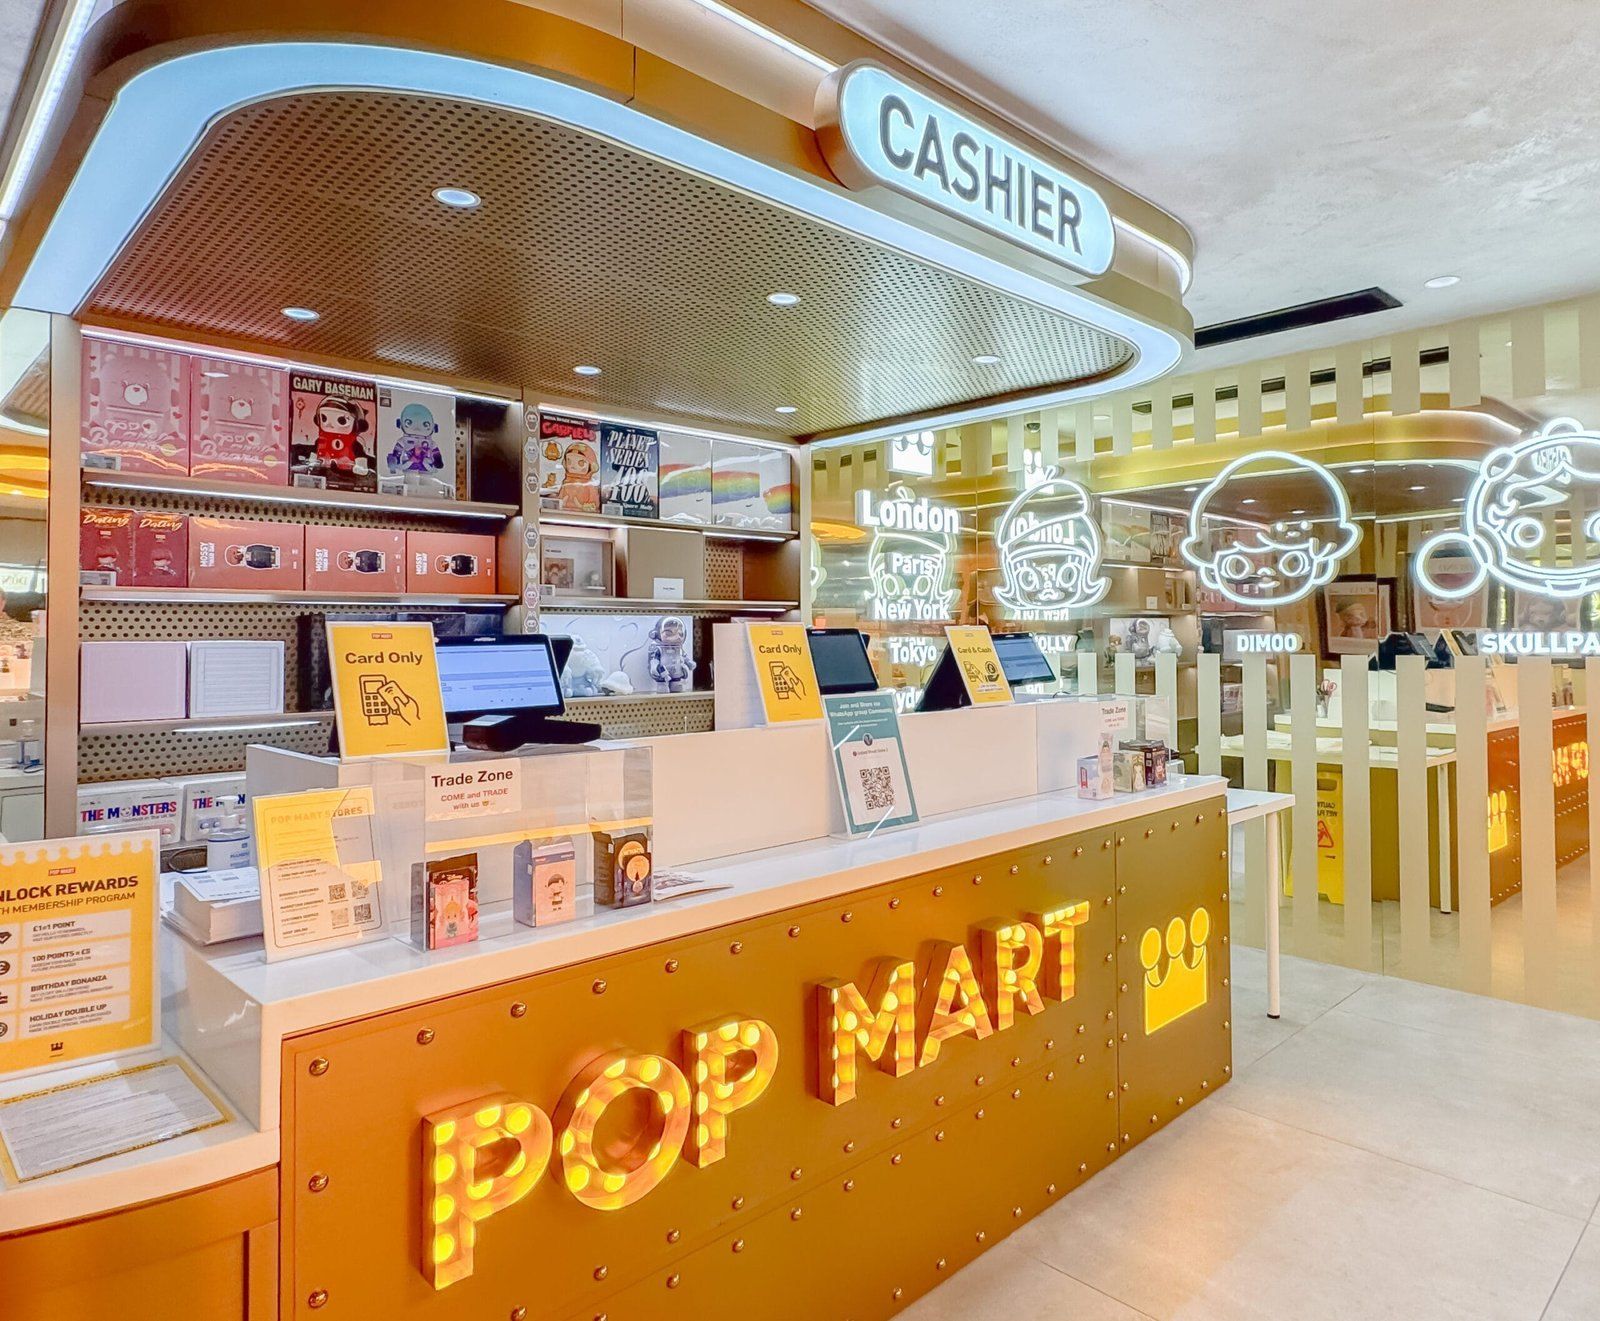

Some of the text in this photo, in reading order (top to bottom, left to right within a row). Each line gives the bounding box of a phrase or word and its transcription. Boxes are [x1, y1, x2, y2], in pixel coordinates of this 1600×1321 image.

[879, 94, 1083, 256] CASHIER
[293, 377, 374, 400] GARY BASEMAN
[608, 430, 656, 452] PLANET
[860, 488, 961, 534] London
[892, 552, 934, 575] Paris
[874, 598, 950, 620] New York
[758, 644, 802, 655] Card Only
[1237, 634, 1298, 652] DIMOO
[1481, 631, 1600, 653] SKULLPA
[345, 651, 423, 666] Card Only
[889, 643, 937, 667] Tokyo
[431, 770, 513, 787] Trade Zone
[193, 796, 213, 810] THE
[441, 788, 509, 802] COME and TRADE
[80, 808, 104, 822] THE
[325, 806, 363, 818] STORES
[453, 802, 469, 810] with
[55, 875, 139, 896] REWARDS
[12, 898, 83, 914] MEMBERSHIP
[85, 892, 136, 905] PROGRAM
[52, 920, 76, 930] POINT
[46, 951, 75, 960] POINTS
[30, 981, 70, 992] BIRTHDAY
[70, 974, 107, 986] BONANZA
[29, 1010, 64, 1022] HOLIDAY
[64, 1005, 95, 1016] DOUBLE
[96, 1003, 107, 1011] UP
[422, 900, 1092, 1291] POP MART
